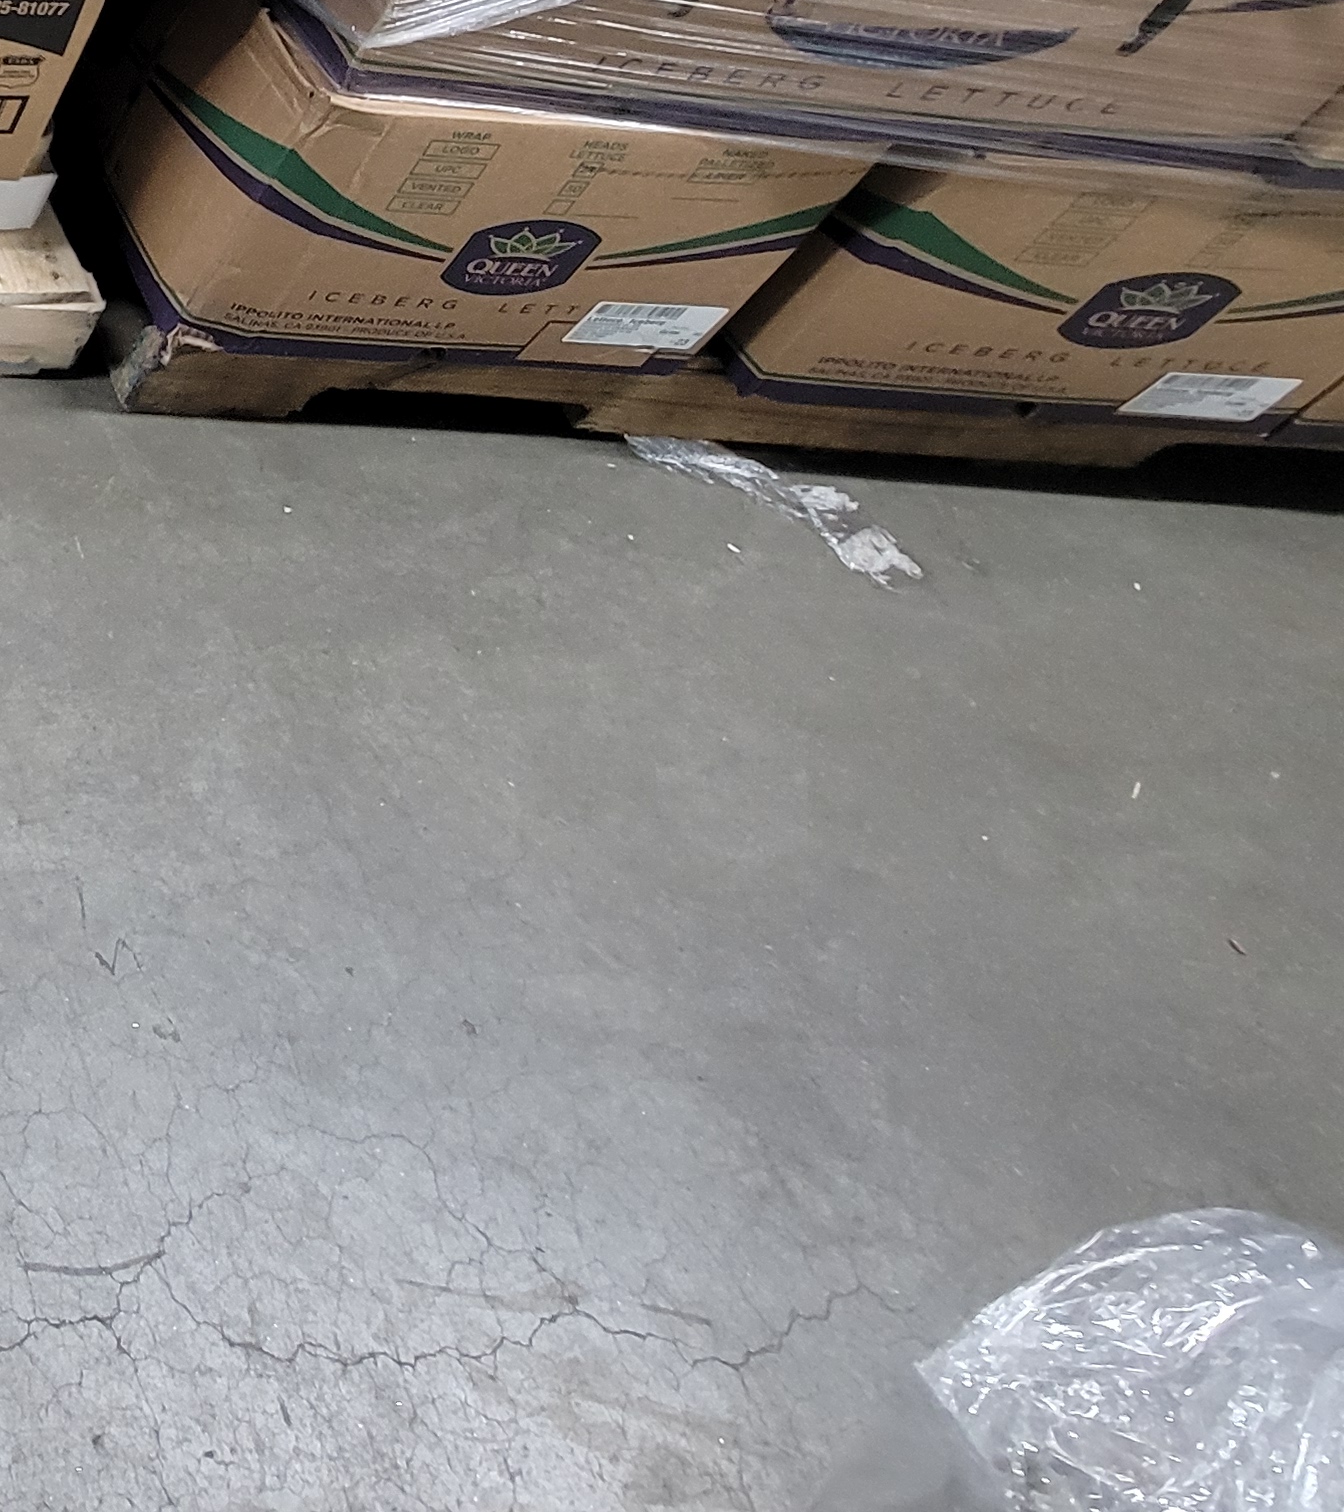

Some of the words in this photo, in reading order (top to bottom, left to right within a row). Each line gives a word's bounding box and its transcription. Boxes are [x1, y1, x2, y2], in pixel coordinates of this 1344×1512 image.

[594, 55, 826, 92] ICEBERG
[885, 80, 1123, 116] LETTUCE
[452, 131, 492, 141] WRAP
[442, 145, 480, 156] LOGO
[434, 164, 462, 174] UPC
[411, 182, 462, 193] VENTED
[401, 201, 443, 211] CLEAR
[465, 259, 559, 278] QUEEN
[464, 273, 545, 288] VICTORIA
[307, 289, 459, 310] ICEBERG
[498, 303, 580, 317] LETT
[230, 301, 304, 320] IPPOLITO
[306, 313, 431, 329] INTERNATIONAL
[1087, 311, 1187, 330] QUEEN
[905, 341, 1071, 364] ICEBERG
[1109, 358, 1272, 373] LETTUCE
